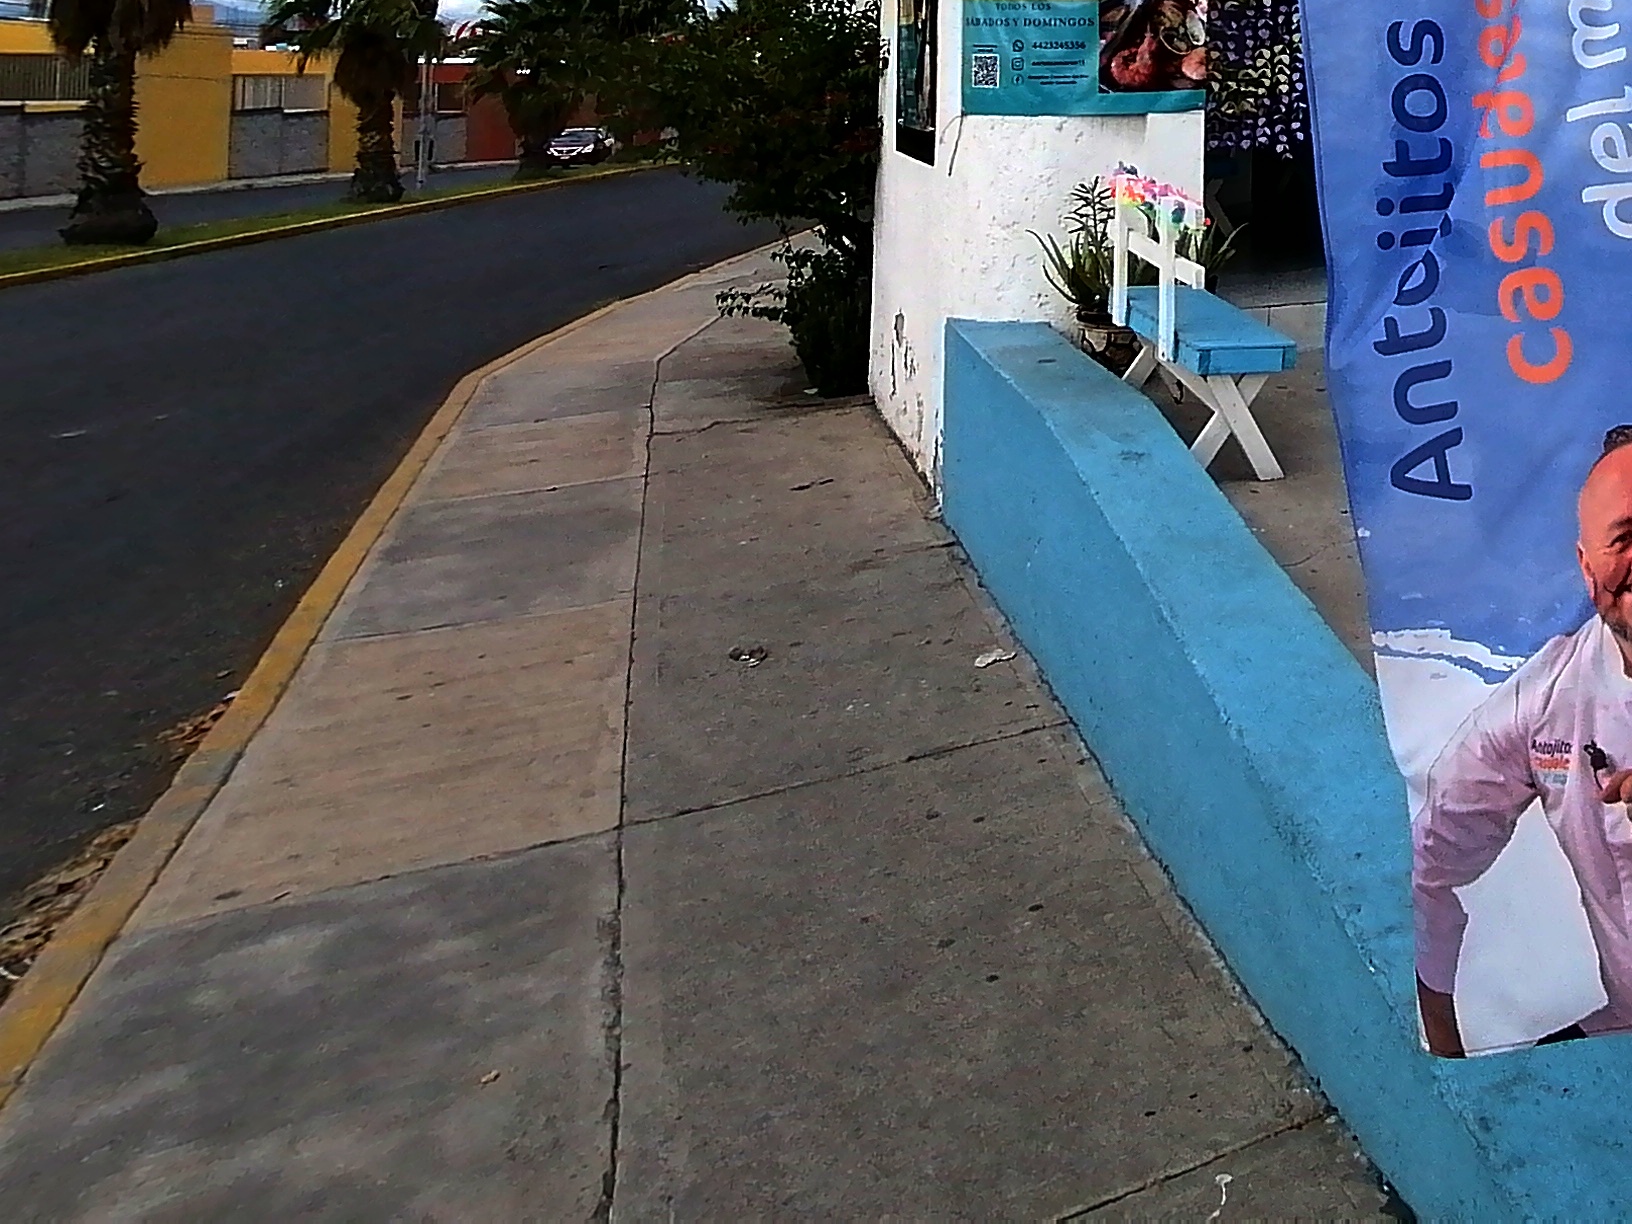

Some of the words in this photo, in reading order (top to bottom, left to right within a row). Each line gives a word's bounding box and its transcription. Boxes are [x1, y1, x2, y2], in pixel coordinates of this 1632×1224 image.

[995, 2, 1027, 11] TODOS
[1031, 2, 1052, 11] LOS
[1012, 17, 1020, 27] Y
[1023, 17, 1095, 27] DOMINGOS
[1373, 18, 1474, 501] Antojitos
